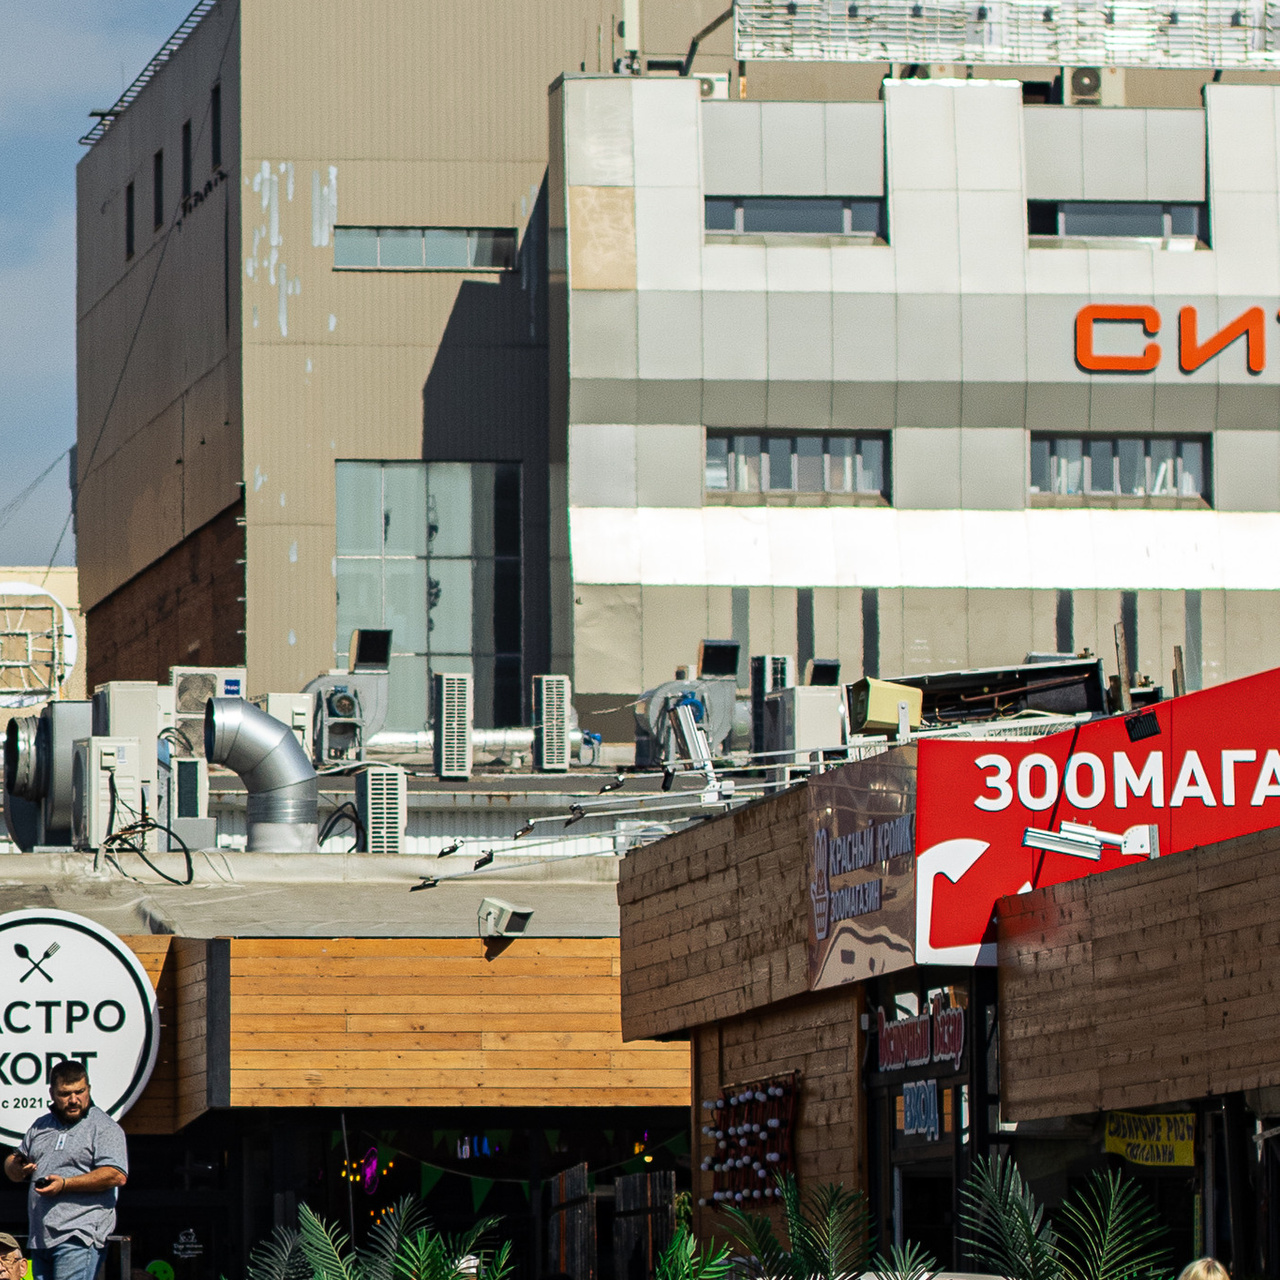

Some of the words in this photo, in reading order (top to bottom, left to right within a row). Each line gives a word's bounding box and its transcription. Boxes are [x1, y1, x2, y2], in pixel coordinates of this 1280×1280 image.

[1074, 304, 1280, 376] СИ
[829, 819, 875, 877] КРАСНЫЙ
[878, 814, 914, 861] КРОЛИК
[830, 879, 881, 923] ЗООМАГАЗИН
[13, 1097, 43, 1109] 2021
[903, 1078, 939, 1141] ВХОД
